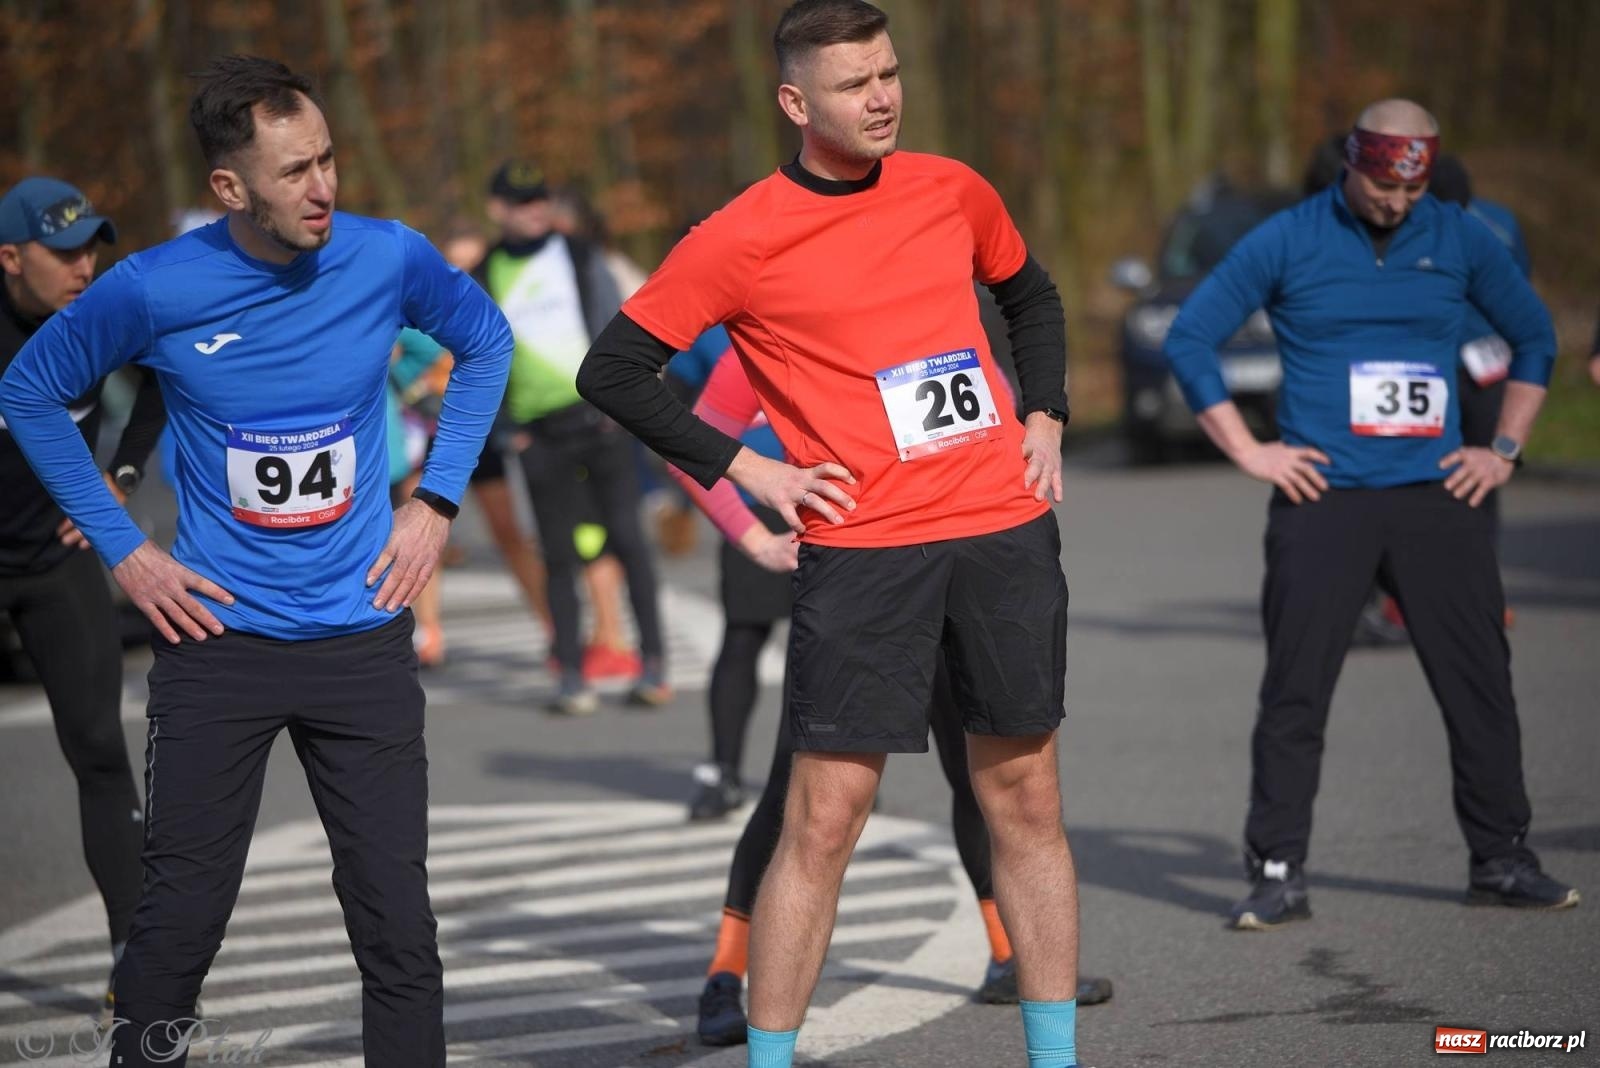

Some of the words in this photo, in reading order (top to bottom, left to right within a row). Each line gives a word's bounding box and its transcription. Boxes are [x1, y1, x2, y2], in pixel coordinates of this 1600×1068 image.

[890, 367, 905, 378] XII
[928, 351, 972, 368] TWARDZIELA
[915, 373, 981, 432] 26
[1376, 380, 1430, 416] 35
[241, 432, 254, 443] XII
[255, 434, 279, 445] BIEG
[281, 424, 341, 444] TWARDZIELA
[938, 435, 970, 448] Racibórz
[279, 443, 302, 453] lutego
[302, 441, 319, 450] 2024
[255, 450, 337, 505] 94
[271, 515, 311, 524] Racibórz
